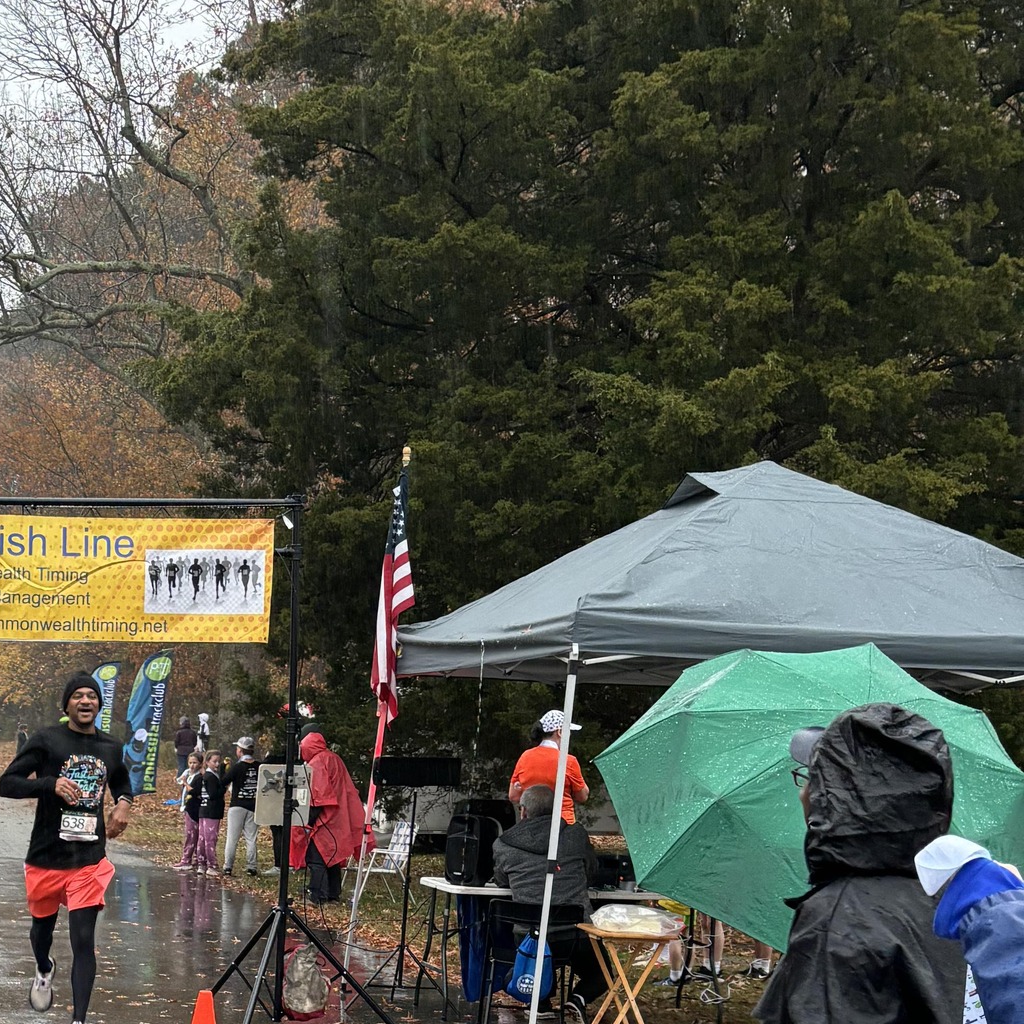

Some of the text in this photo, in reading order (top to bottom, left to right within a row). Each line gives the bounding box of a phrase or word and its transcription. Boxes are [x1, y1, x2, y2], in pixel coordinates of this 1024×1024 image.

[61, 525, 135, 558] Line
[36, 566, 89, 584] Timing
[62, 816, 86, 830] 638
